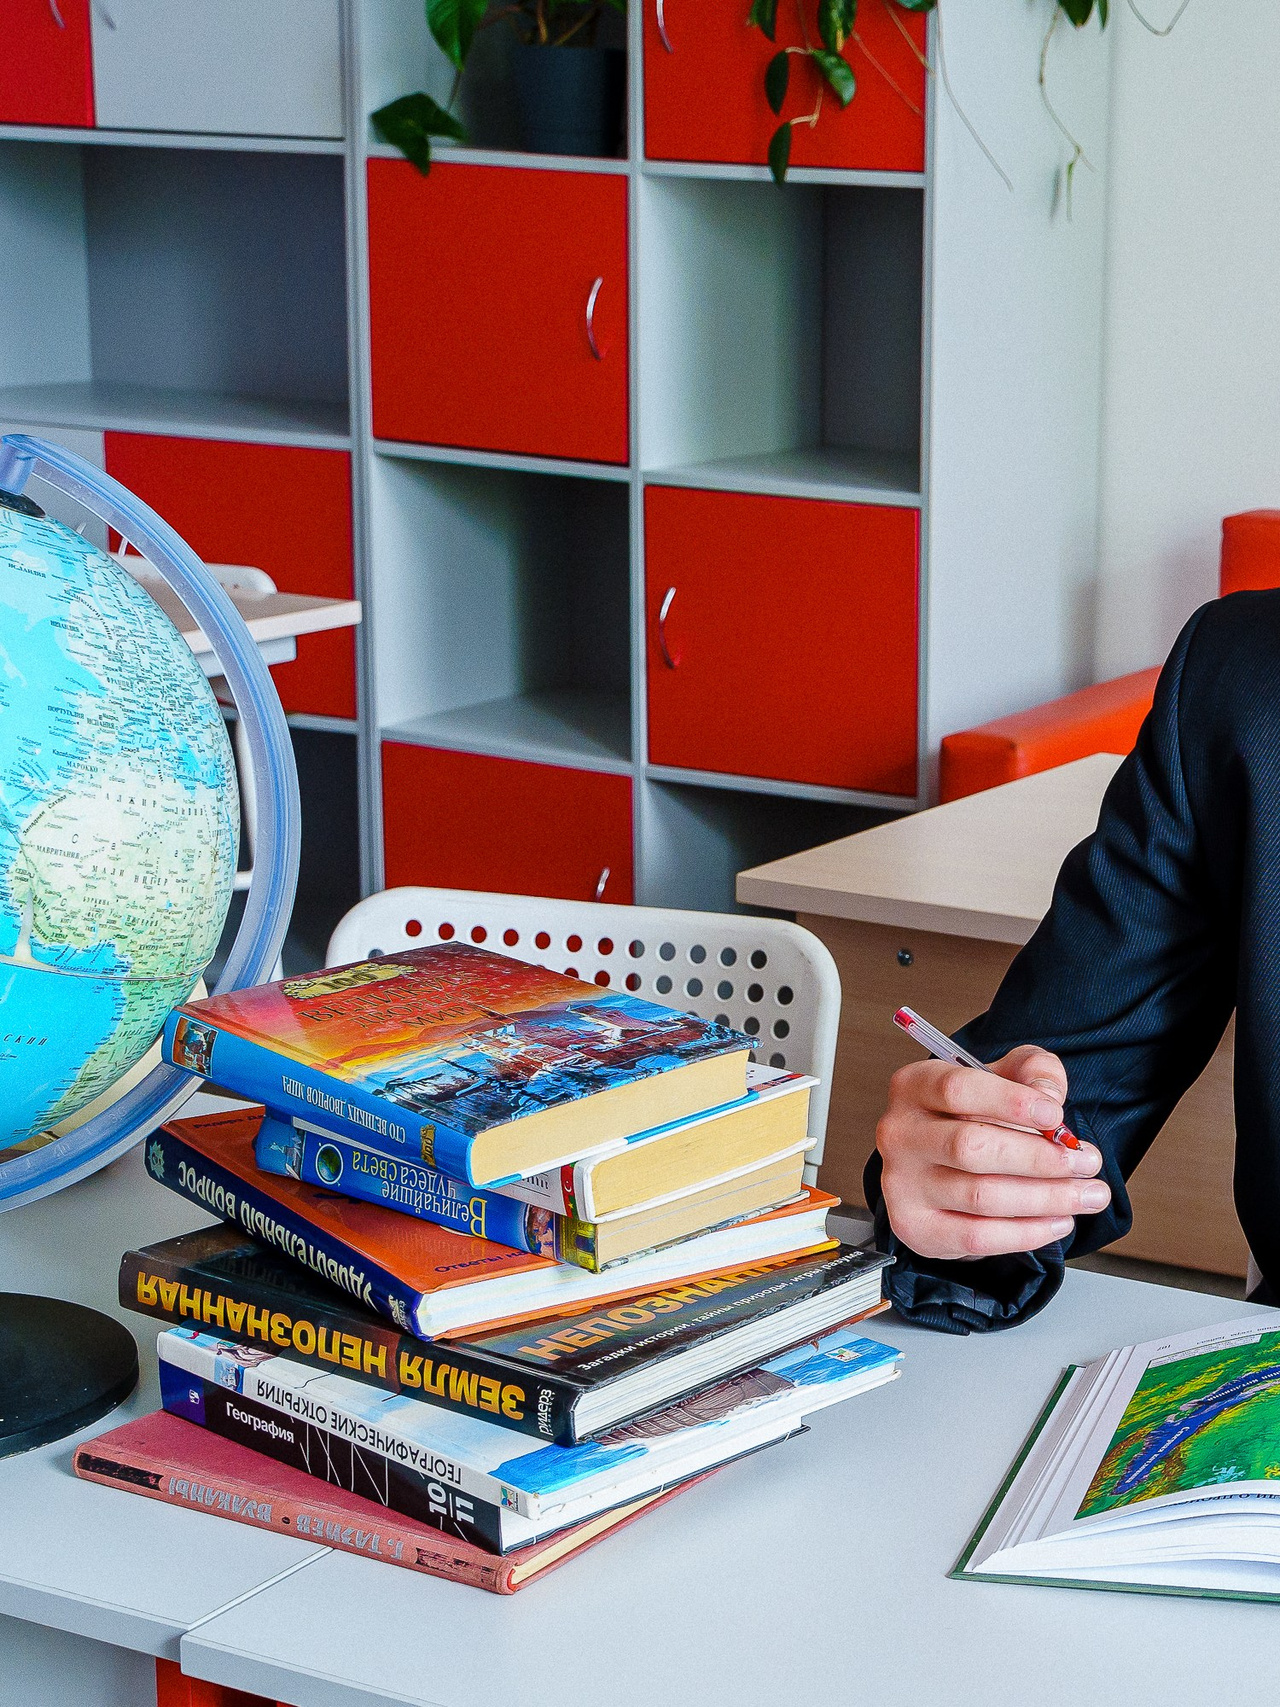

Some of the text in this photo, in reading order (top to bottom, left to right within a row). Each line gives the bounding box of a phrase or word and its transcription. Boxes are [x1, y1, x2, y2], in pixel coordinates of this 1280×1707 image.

[281, 1075, 407, 1145] СТО ВЕЛИКИХ ДВОРЦОВ МИРА
[352, 1150, 458, 1201] чудеса света
[178, 1160, 381, 1314] Удивительный вопрос
[381, 1180, 489, 1240] Величайшие
[434, 1255, 503, 1273] Ответы
[137, 1270, 388, 1379] НЕПОЗНАННАЯ
[577, 1249, 865, 1371] Загадки истории, тайны природы, игры разума
[399, 1349, 526, 1421] ЗЕМЛЯ
[226, 1401, 295, 1444] География
[257, 1378, 462, 1486] ГЕОГРАФИЧЕСКИЕ ОТКРЫТИЯ
[168, 1476, 273, 1523] ВУЛКАНЫ
[427, 1482, 447, 1516] 10
[455, 1496, 475, 1525] 11
